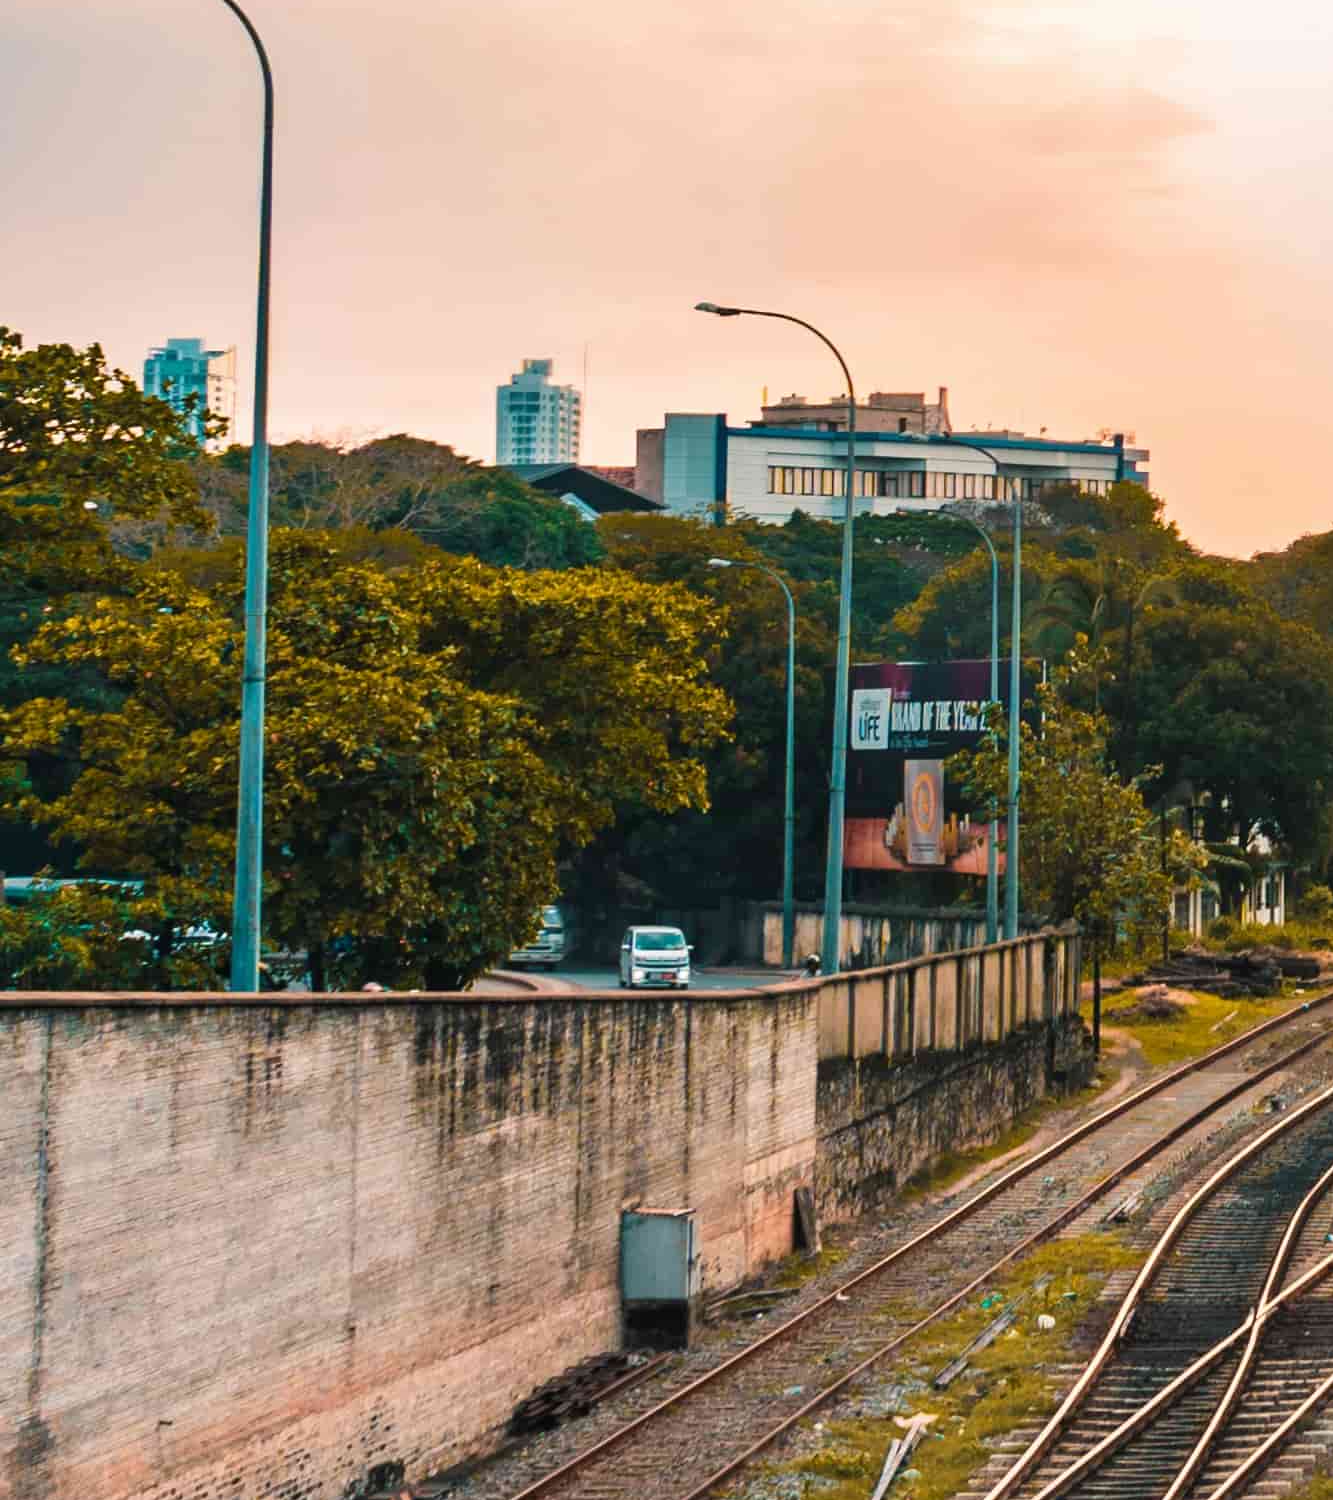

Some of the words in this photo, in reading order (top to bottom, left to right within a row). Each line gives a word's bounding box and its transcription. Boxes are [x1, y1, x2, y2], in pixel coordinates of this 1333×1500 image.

[891, 701, 921, 732] BRAND
[922, 701, 935, 732] OF
[936, 701, 952, 732] THE
